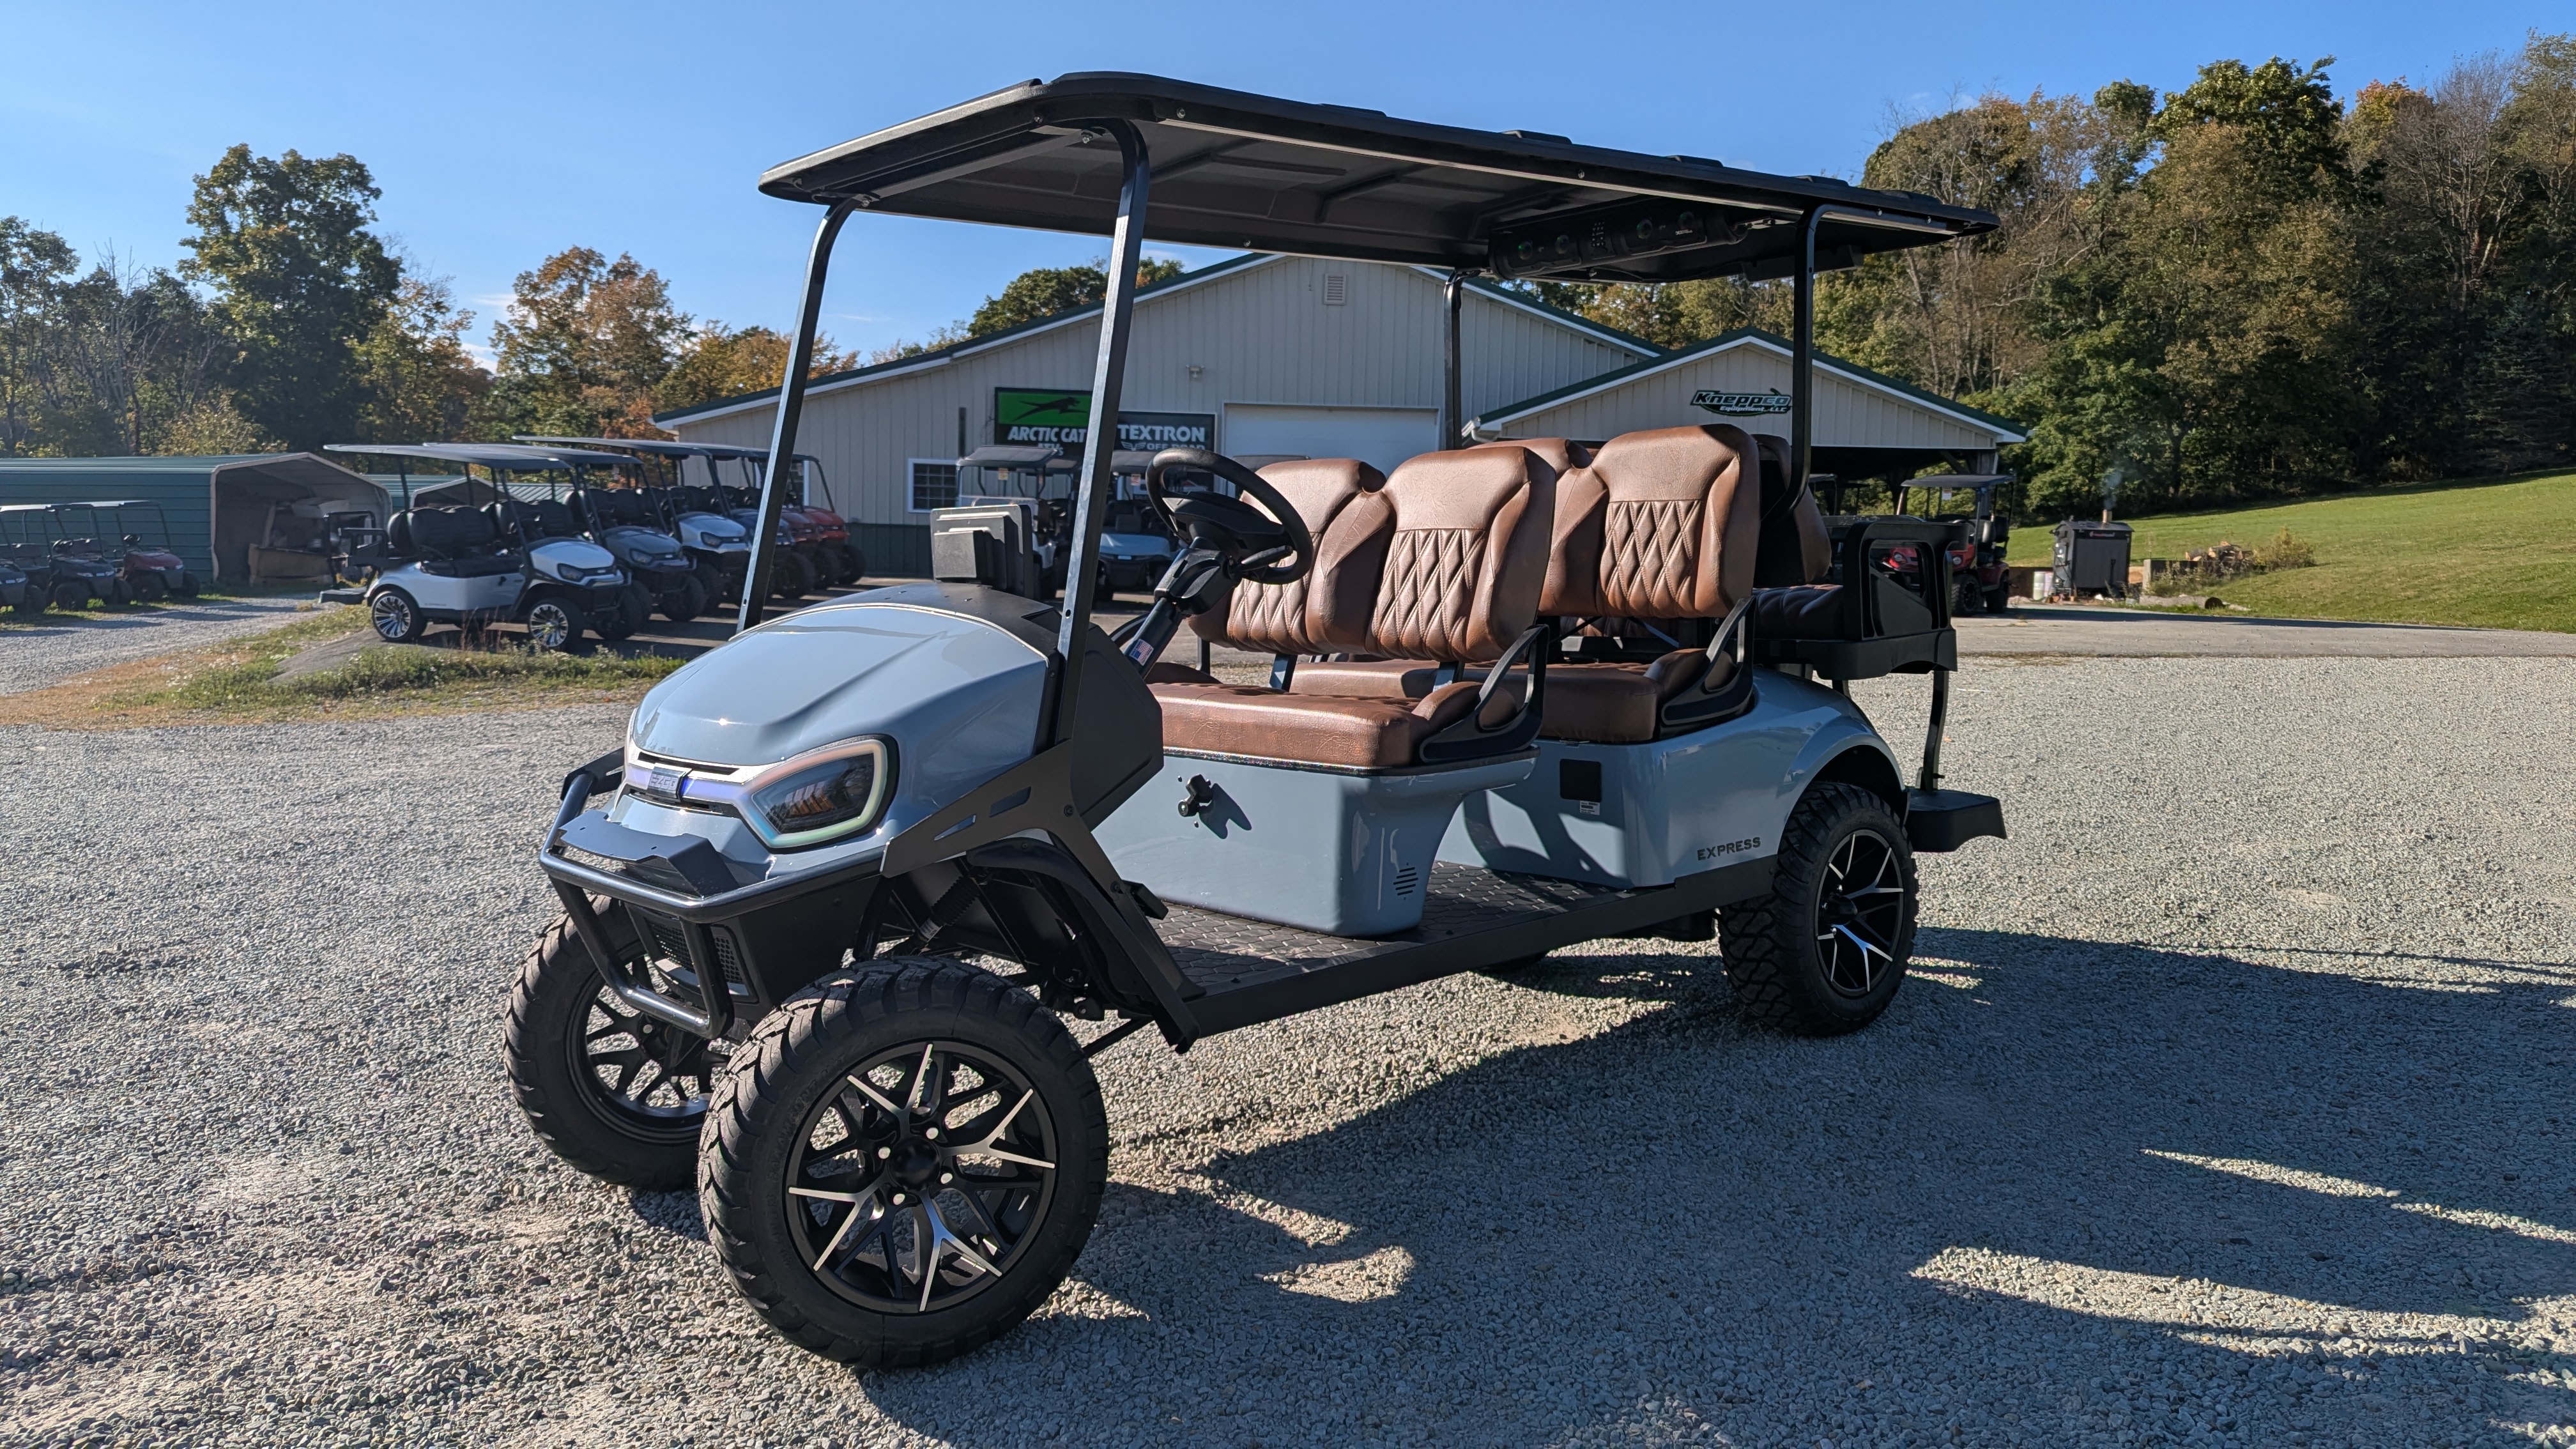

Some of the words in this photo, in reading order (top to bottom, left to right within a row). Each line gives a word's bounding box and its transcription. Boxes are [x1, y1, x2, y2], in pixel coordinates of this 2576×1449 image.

[1693, 392, 1790, 408] Kneppco
[1008, 426, 1059, 442] ARCTIC
[1061, 428, 1087, 443] CAT
[1117, 424, 1206, 443] TEXTRON
[1697, 836, 1761, 861] EXPRESS
